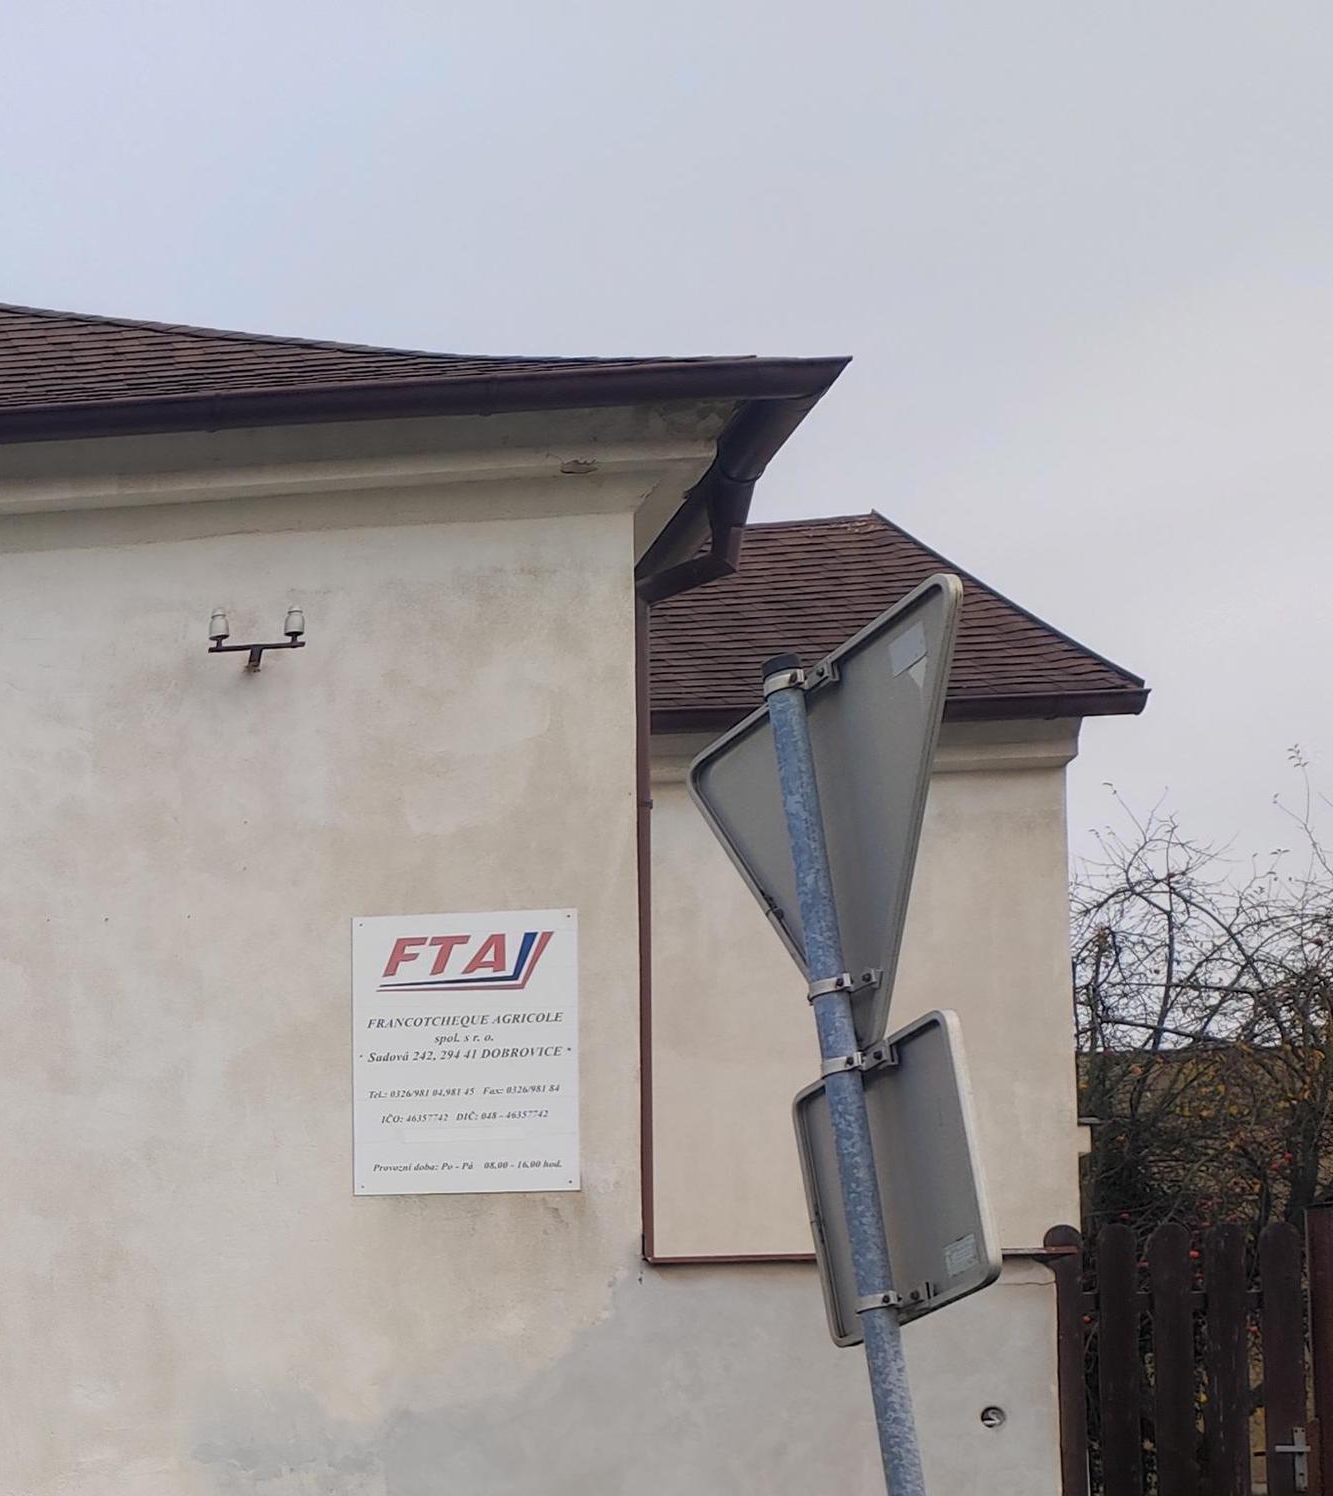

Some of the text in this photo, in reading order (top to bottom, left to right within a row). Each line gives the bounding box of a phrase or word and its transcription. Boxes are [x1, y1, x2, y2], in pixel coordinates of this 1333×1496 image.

[382, 933, 506, 977] FTA
[367, 1011, 564, 1029] FRANCOTCHEQUE AGRICOLE
[464, 1034, 470, 1042] s
[473, 1034, 480, 1042] r.
[484, 1034, 494, 1042] o.
[367, 1051, 409, 1063] Sadová
[440, 1049, 460, 1060] 294
[464, 1048, 477, 1059] 41
[481, 1045, 563, 1059] DOBROVICE
[483, 1086, 503, 1095] Fax:
